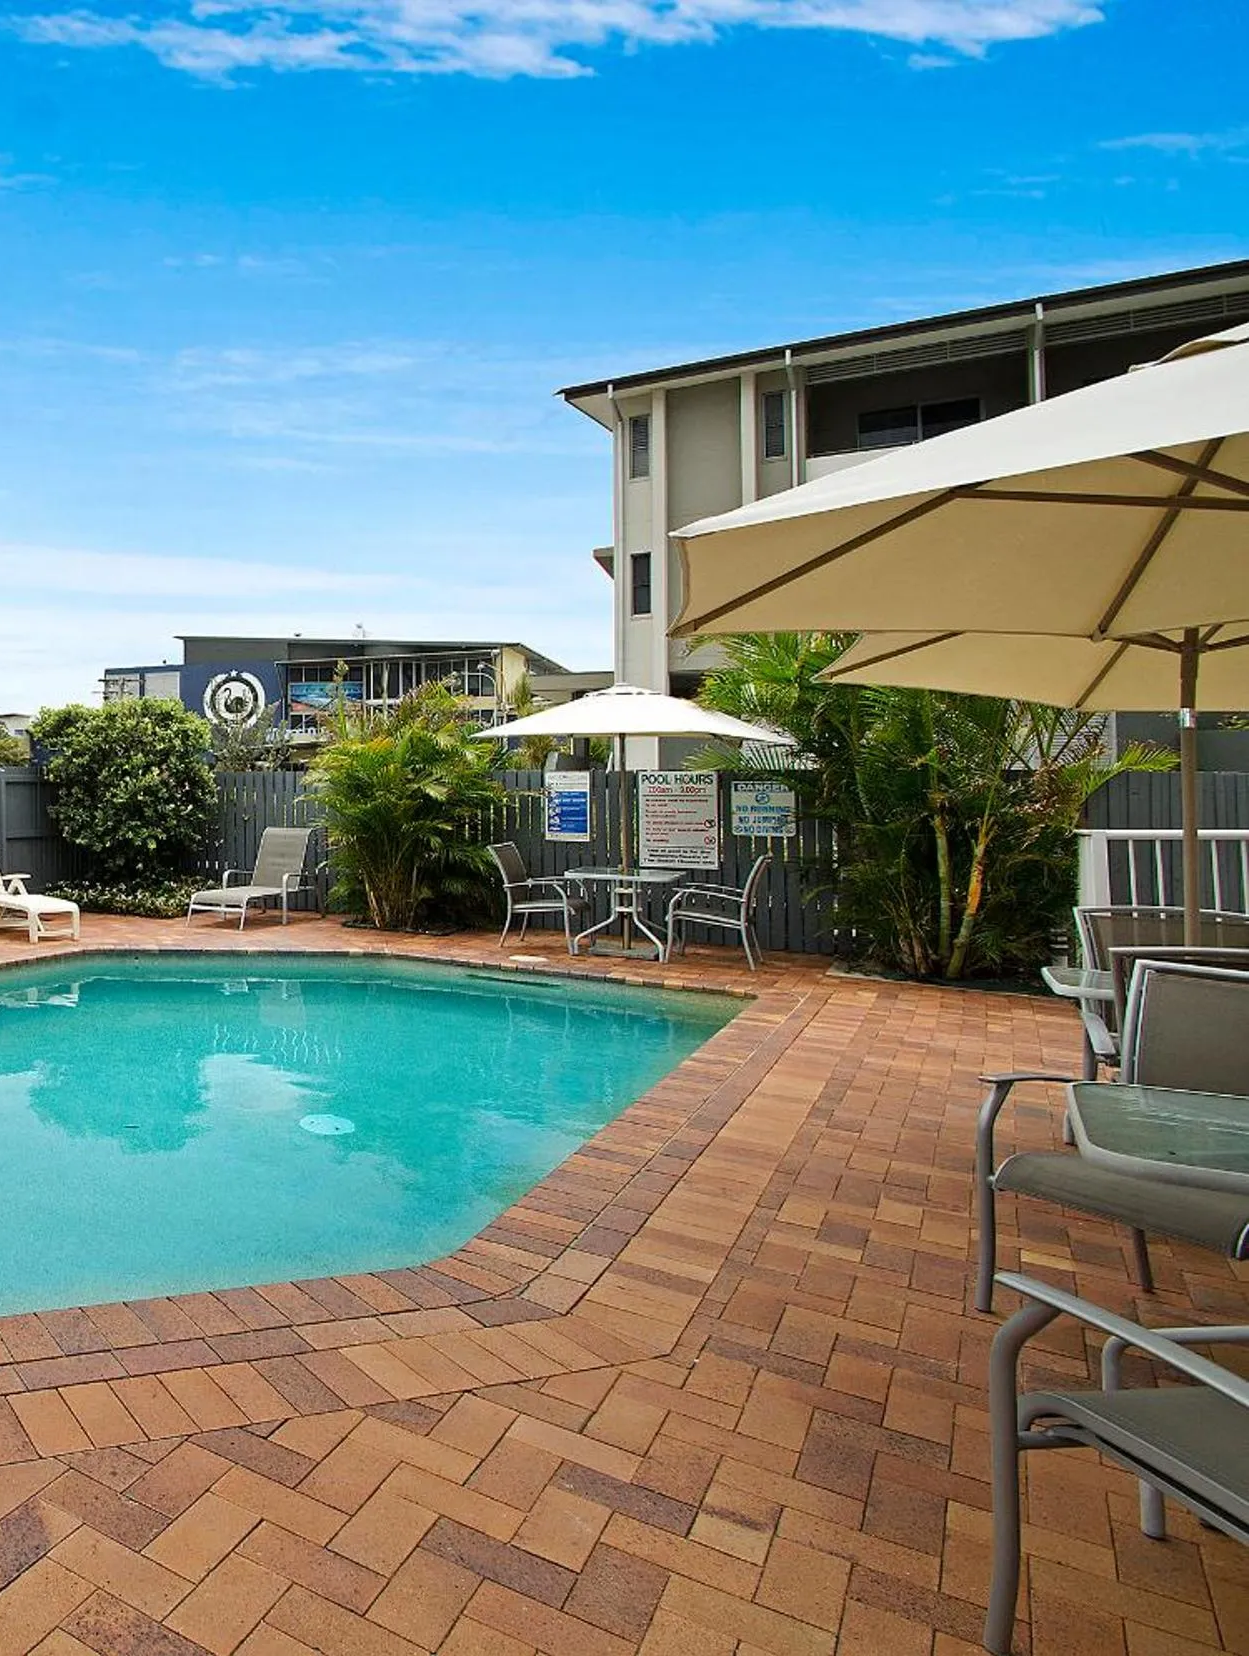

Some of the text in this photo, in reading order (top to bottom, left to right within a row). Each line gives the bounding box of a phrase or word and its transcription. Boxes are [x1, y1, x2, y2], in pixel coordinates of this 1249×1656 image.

[641, 774, 715, 786] POOL HOURS
[736, 783, 791, 793] DANGER
